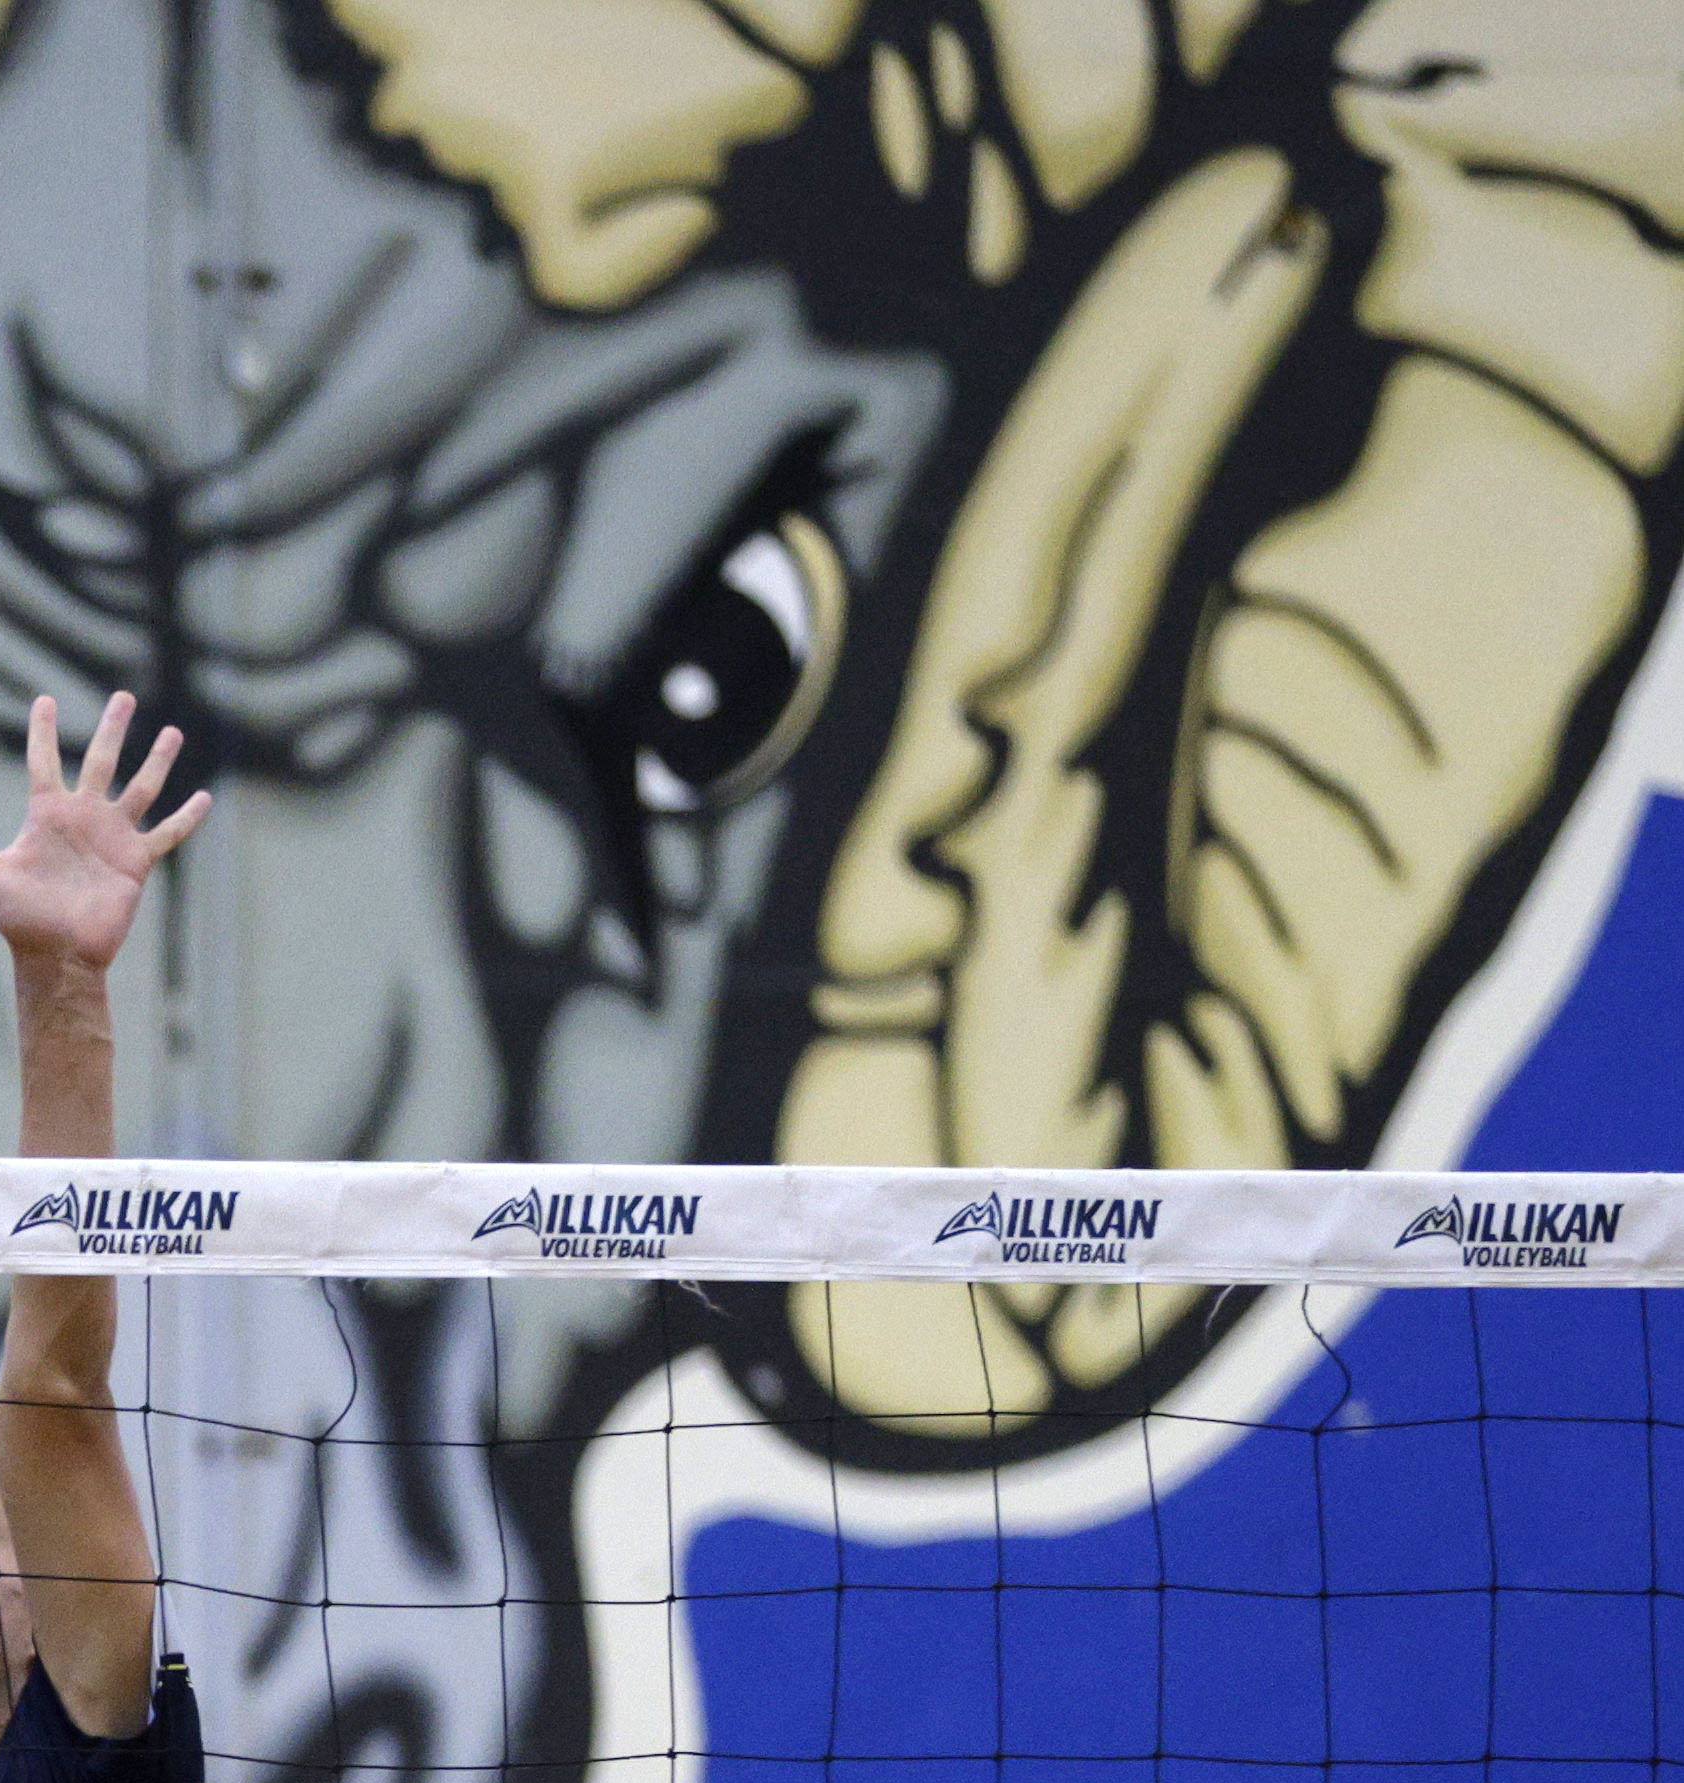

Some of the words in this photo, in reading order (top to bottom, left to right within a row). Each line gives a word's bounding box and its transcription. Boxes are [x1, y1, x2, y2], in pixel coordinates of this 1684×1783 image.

[79, 1234, 203, 1254] VOLLEYBALL
[540, 1239, 666, 1259] VOLLEYBALL
[1002, 1243, 1127, 1263] VOLLEYBALL
[1463, 1247, 1588, 1267] VOLLEYBALL
